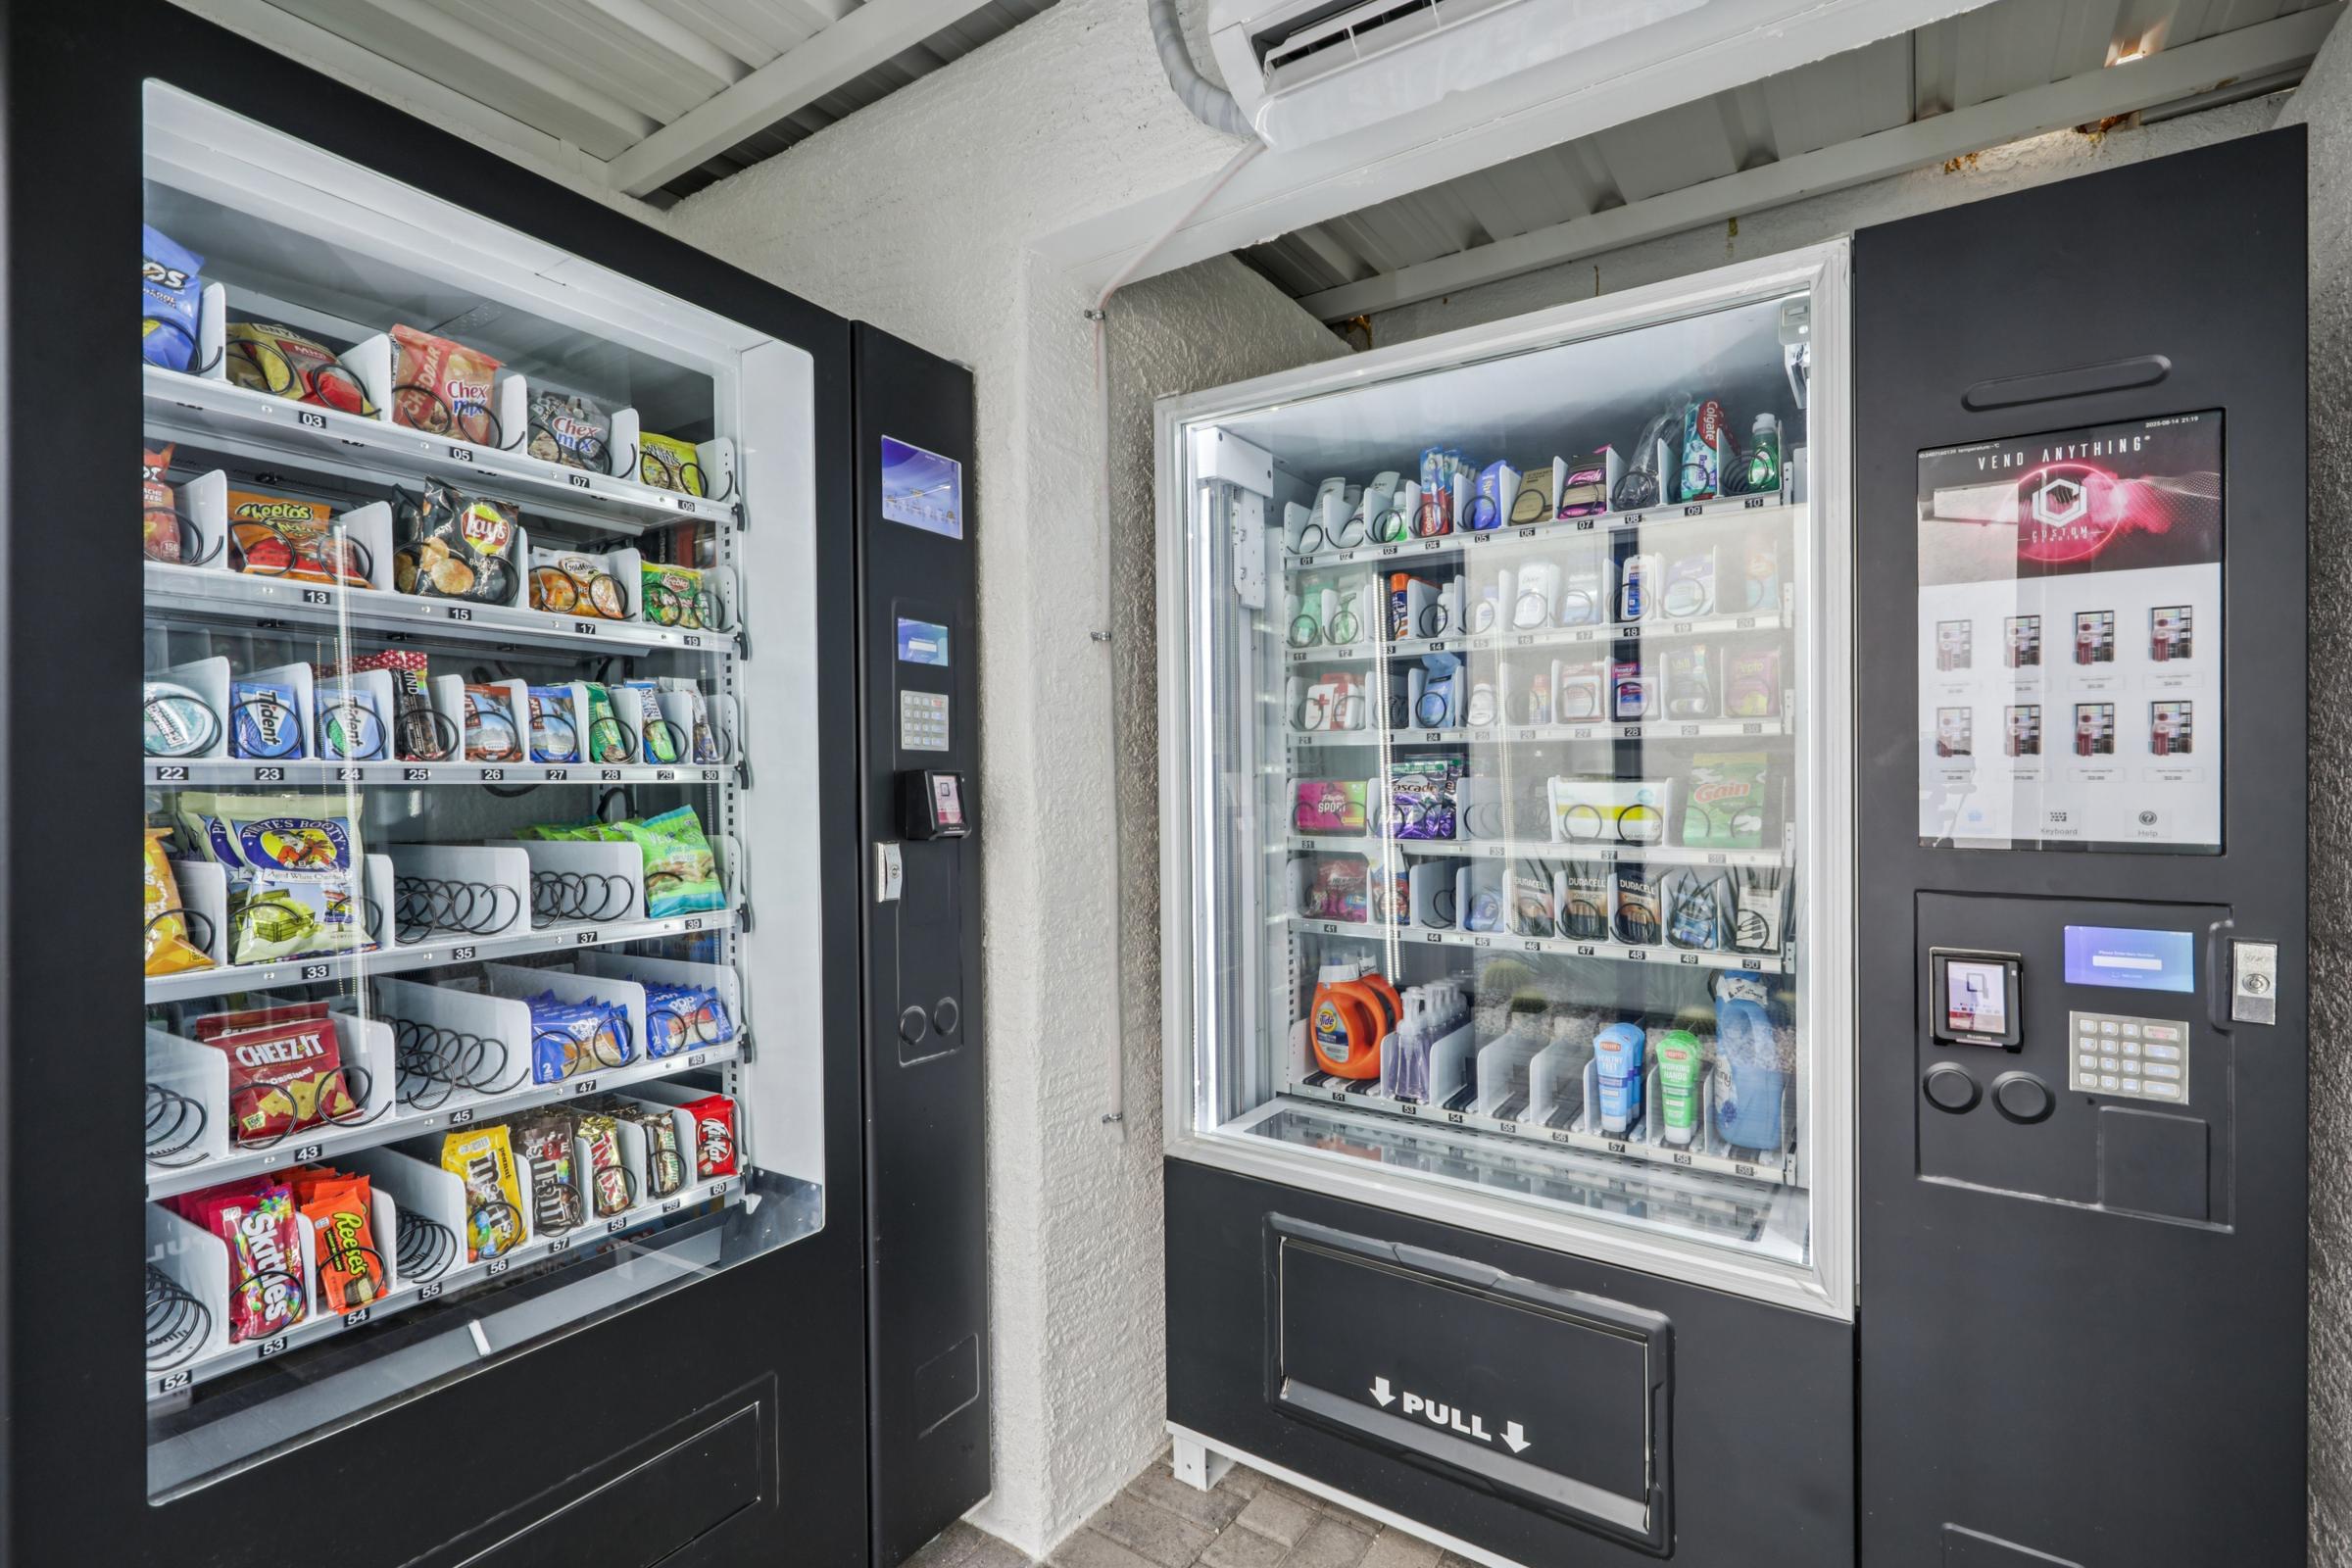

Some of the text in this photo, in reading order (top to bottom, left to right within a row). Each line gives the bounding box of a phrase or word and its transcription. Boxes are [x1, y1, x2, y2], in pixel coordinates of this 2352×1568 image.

[447, 379, 490, 400] Chex
[302, 414, 323, 428] 03
[552, 416, 603, 437] Chex
[1705, 401, 1718, 440] Colgate
[453, 449, 471, 461] 05
[1978, 452, 2024, 470] VEND
[572, 476, 588, 487] 07
[680, 501, 695, 512] 09
[1746, 499, 1761, 508] 10
[236, 503, 312, 521] Cheetos
[1688, 506, 1701, 515] 09
[466, 505, 508, 544] Lay's
[1626, 514, 1641, 523] 08
[1578, 520, 1592, 530] 07
[2032, 526, 2088, 538] CUSTOM
[1425, 541, 1438, 550] 04
[307, 591, 327, 604] 13
[452, 609, 469, 620] 15
[579, 624, 595, 634] 17
[1626, 627, 1638, 636] 18
[685, 636, 699, 646] 19
[404, 668, 419, 696] KIND
[256, 689, 283, 747] Trident
[345, 695, 365, 747] Trident
[1626, 727, 1639, 736] 28
[160, 767, 184, 780] 22
[259, 768, 280, 780] 23
[340, 768, 361, 780] 24
[409, 768, 427, 780] 25
[484, 769, 501, 780] 26
[550, 770, 564, 780] 27
[605, 770, 618, 780] 28
[660, 770, 673, 780] 29
[705, 770, 717, 780] 30
[1393, 781, 1440, 794] ascade
[1694, 783, 1751, 804] Gain
[242, 817, 294, 839] PIRATE'S
[300, 819, 346, 843] BOOTY
[1568, 877, 1606, 889] DURACELL
[1619, 879, 1656, 895] DURACELL
[688, 919, 701, 929] 39
[580, 932, 596, 943] 37
[456, 948, 473, 959] 35
[1579, 946, 1592, 955] 47
[1630, 951, 1643, 959] 48
[1682, 955, 1696, 963] 49
[1744, 959, 1759, 969] 50
[307, 966, 327, 978] 33
[1319, 1013, 1335, 1027] Tide
[235, 1034, 324, 1068] CHEEZ-IT
[691, 1054, 705, 1065] 49
[543, 1062, 552, 1073] 2
[579, 1081, 594, 1093] 47
[452, 1109, 470, 1123] 45
[1449, 1113, 1461, 1122] 54
[1501, 1123, 1514, 1132] 55
[1554, 1132, 1567, 1141] 56
[297, 1146, 318, 1159] 43
[1610, 1143, 1623, 1152] 57
[1676, 1154, 1690, 1163] 58
[1738, 1165, 1752, 1175] 59
[713, 1183, 726, 1194] 60
[665, 1200, 679, 1209] 59
[611, 1218, 625, 1230] 58
[553, 1240, 568, 1250] 57
[241, 1212, 287, 1322] Skittles
[490, 1260, 507, 1272] 56
[422, 1284, 440, 1298] 55
[347, 1311, 368, 1324] 54
[263, 1340, 284, 1354] 53
[164, 1374, 188, 1390] 52
[1402, 1391, 1492, 1442] PULL
